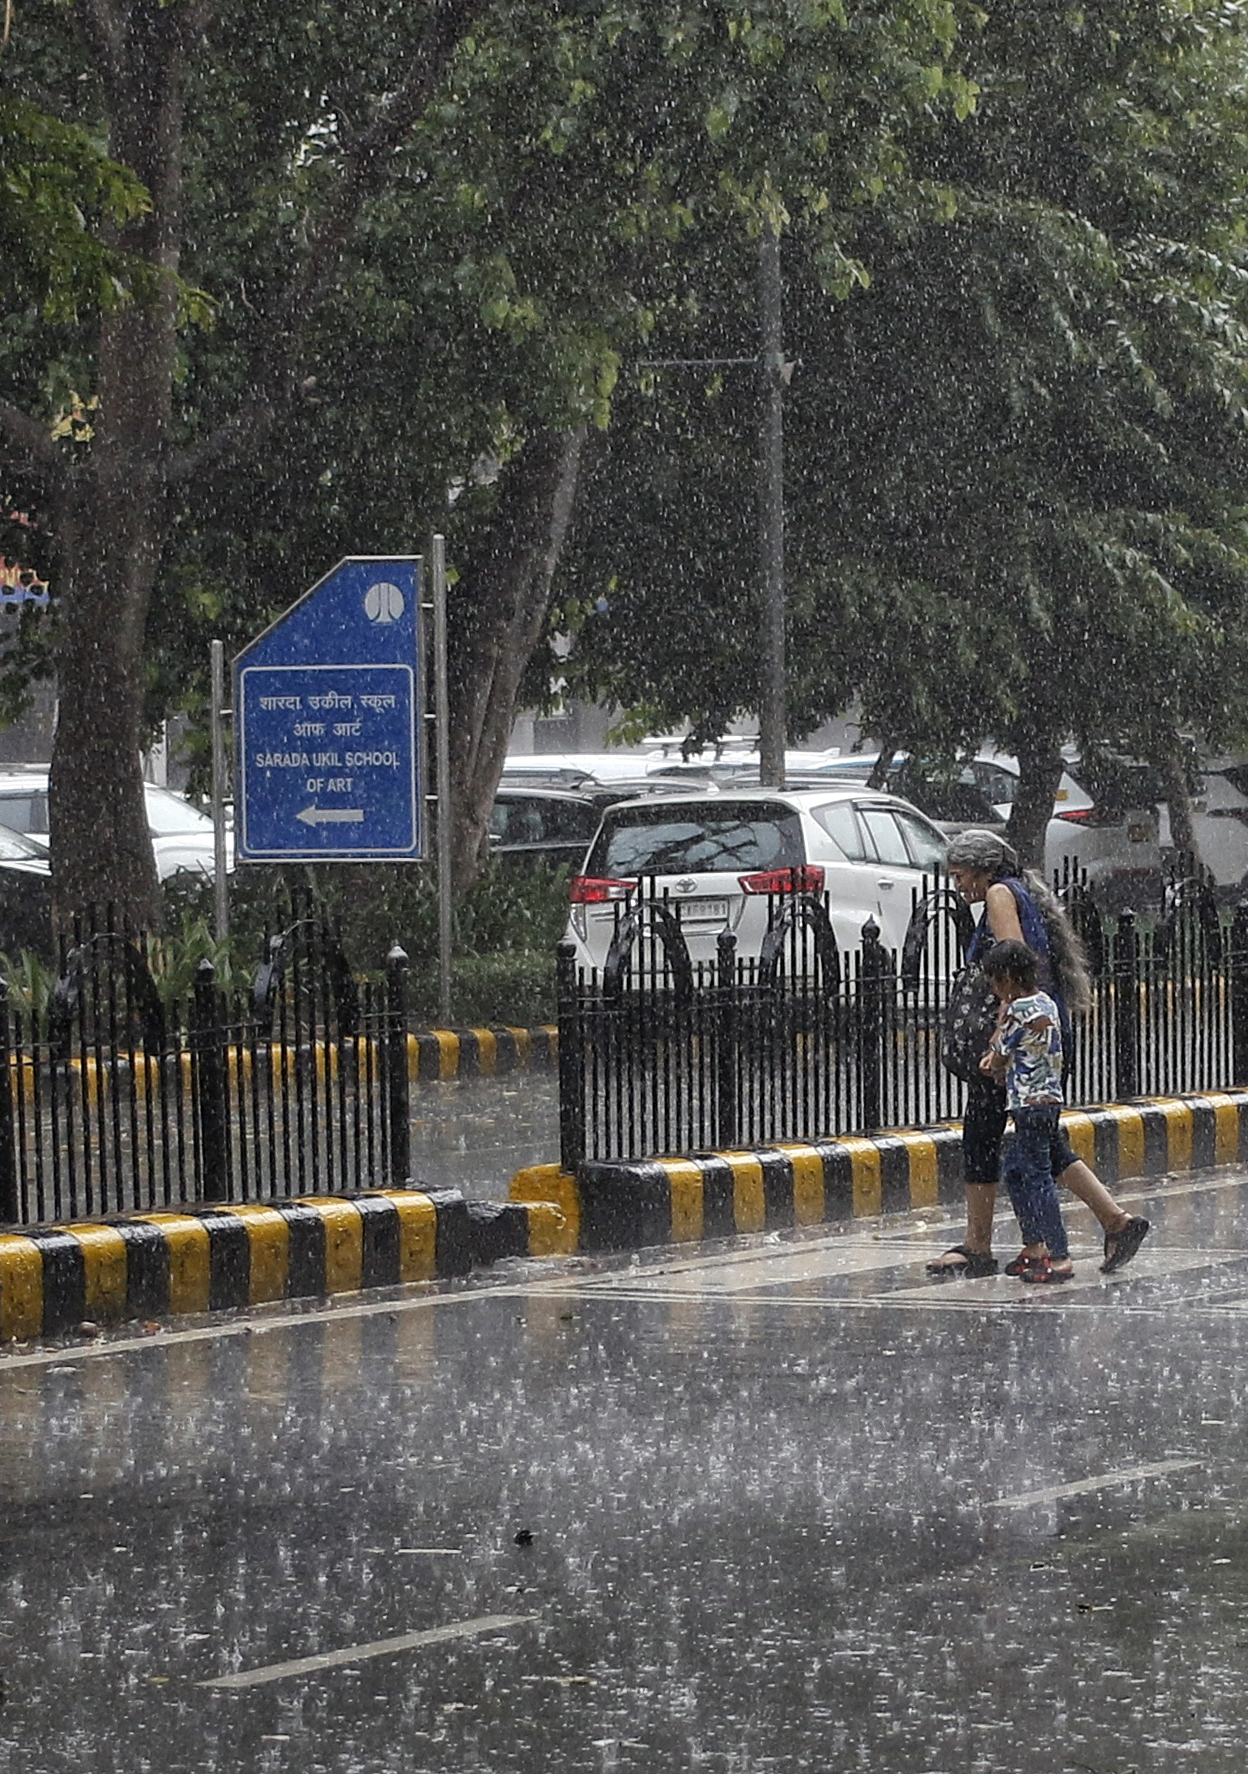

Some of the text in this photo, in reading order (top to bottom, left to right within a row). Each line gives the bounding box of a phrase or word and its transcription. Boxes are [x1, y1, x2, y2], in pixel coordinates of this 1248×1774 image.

[259, 690, 396, 713] शारदा उकील स्कूल
[333, 717, 362, 736] आर्ट
[255, 751, 400, 767] SARADA UKIL SCHOOL
[306, 777, 353, 793] OF ART
